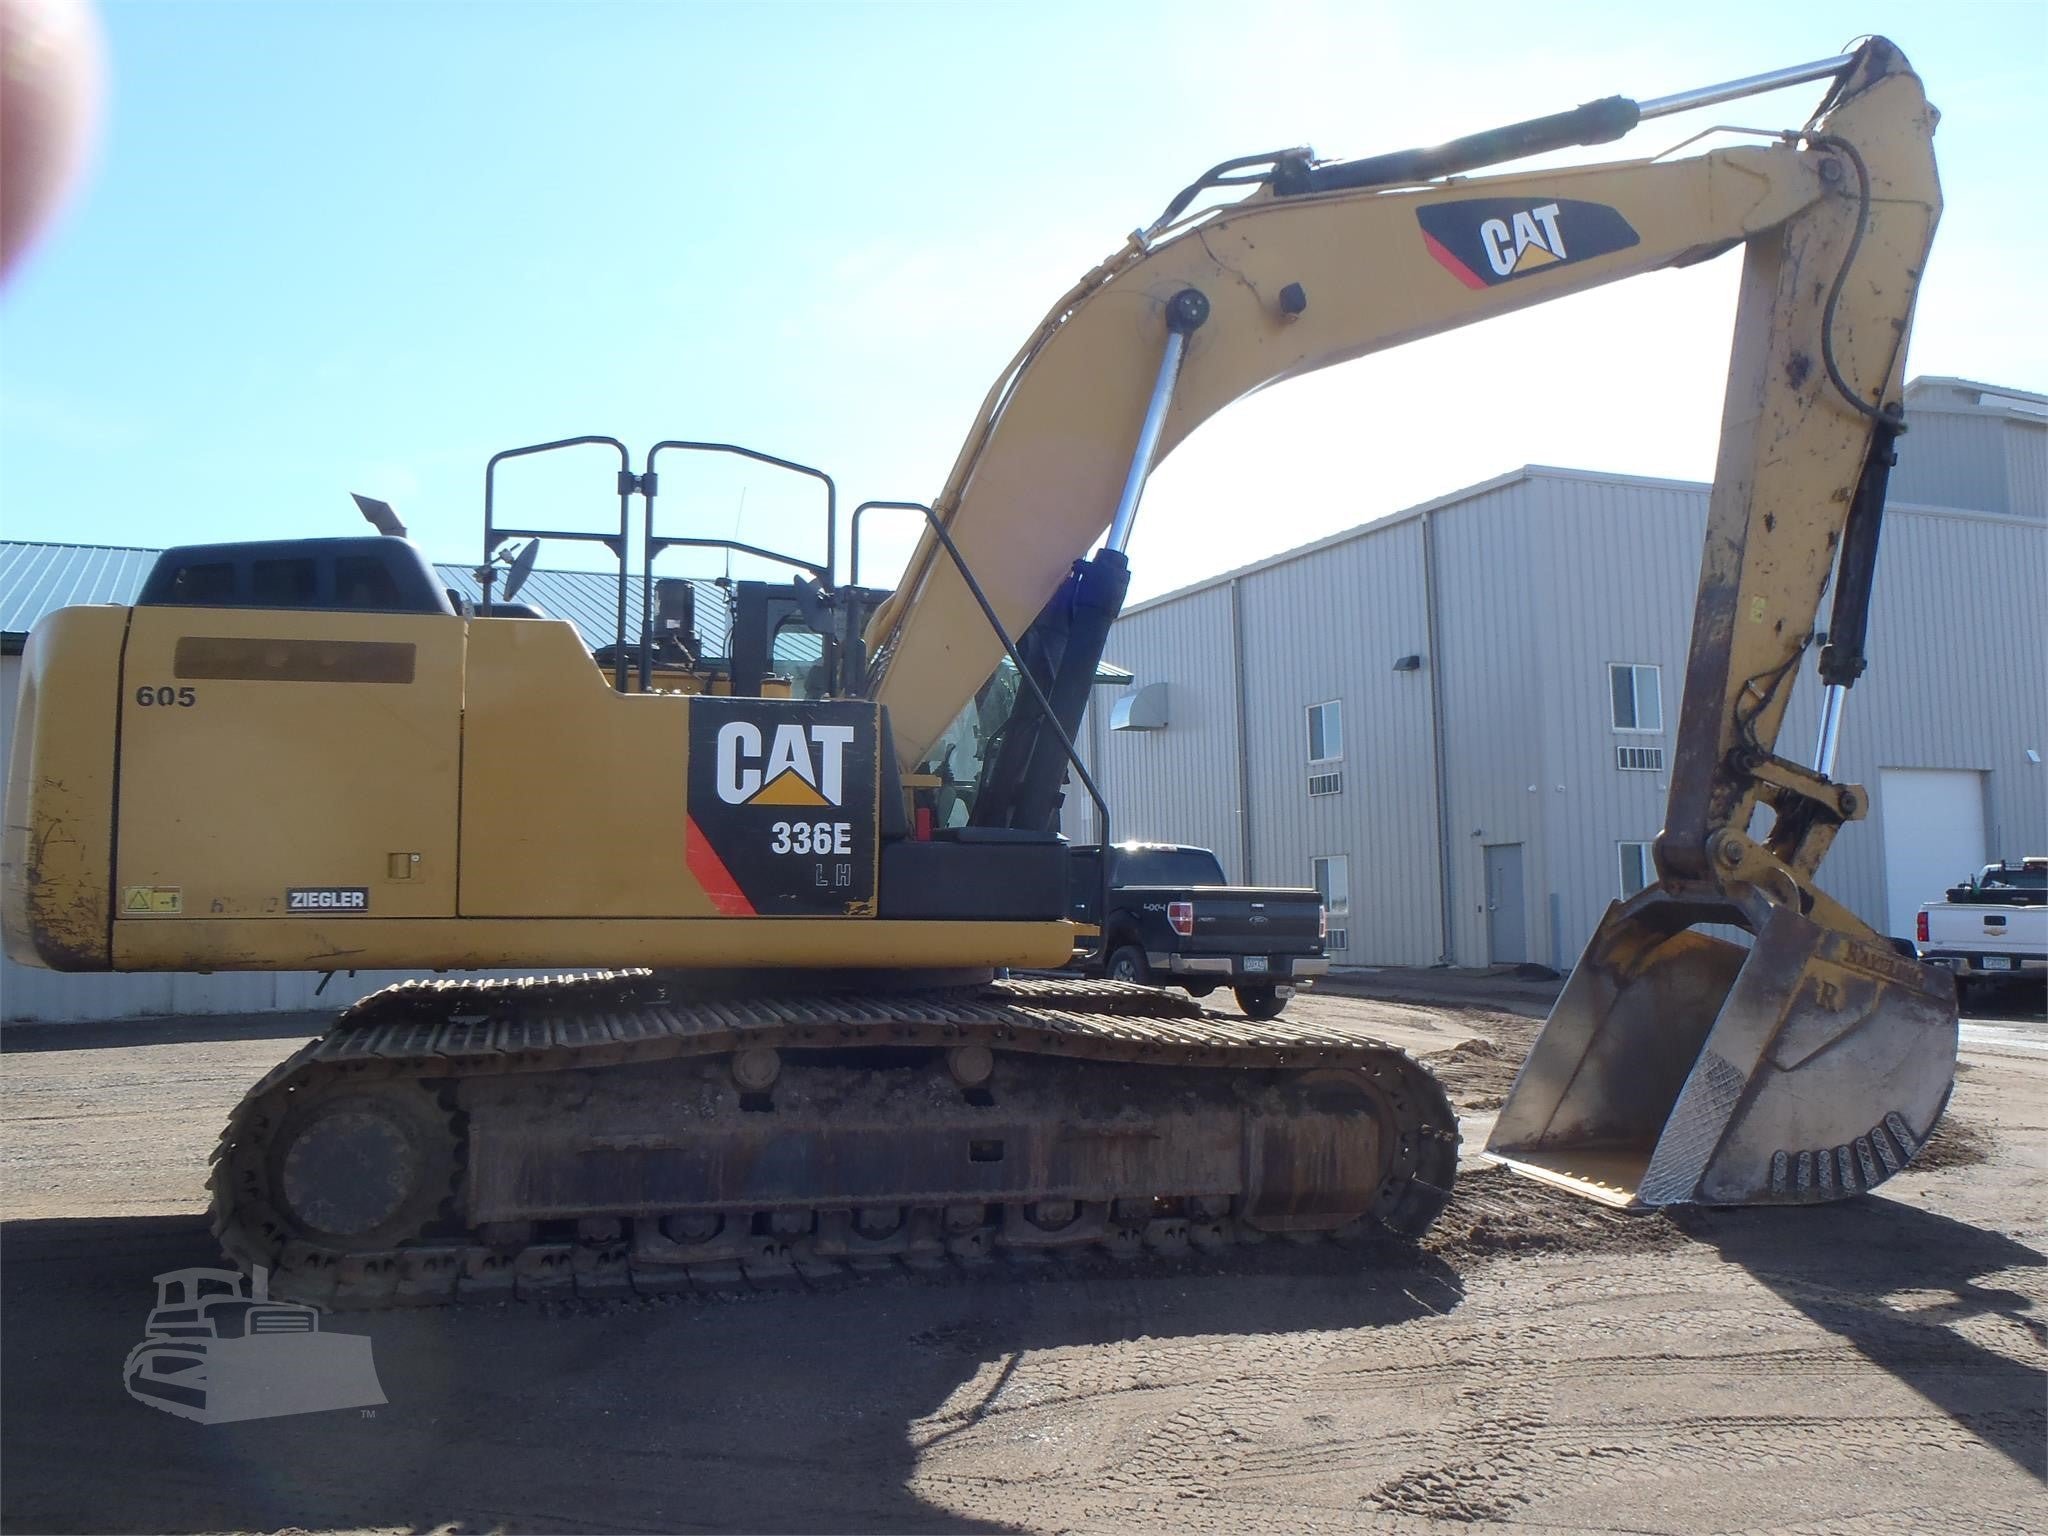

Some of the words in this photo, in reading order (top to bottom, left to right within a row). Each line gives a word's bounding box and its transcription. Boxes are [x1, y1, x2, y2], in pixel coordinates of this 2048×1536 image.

[1480, 203, 1567, 276] CAT
[136, 686, 196, 707] 605
[716, 721, 854, 806] CAT
[771, 822, 851, 854] 336E
[291, 891, 365, 908] ZIEGLER
